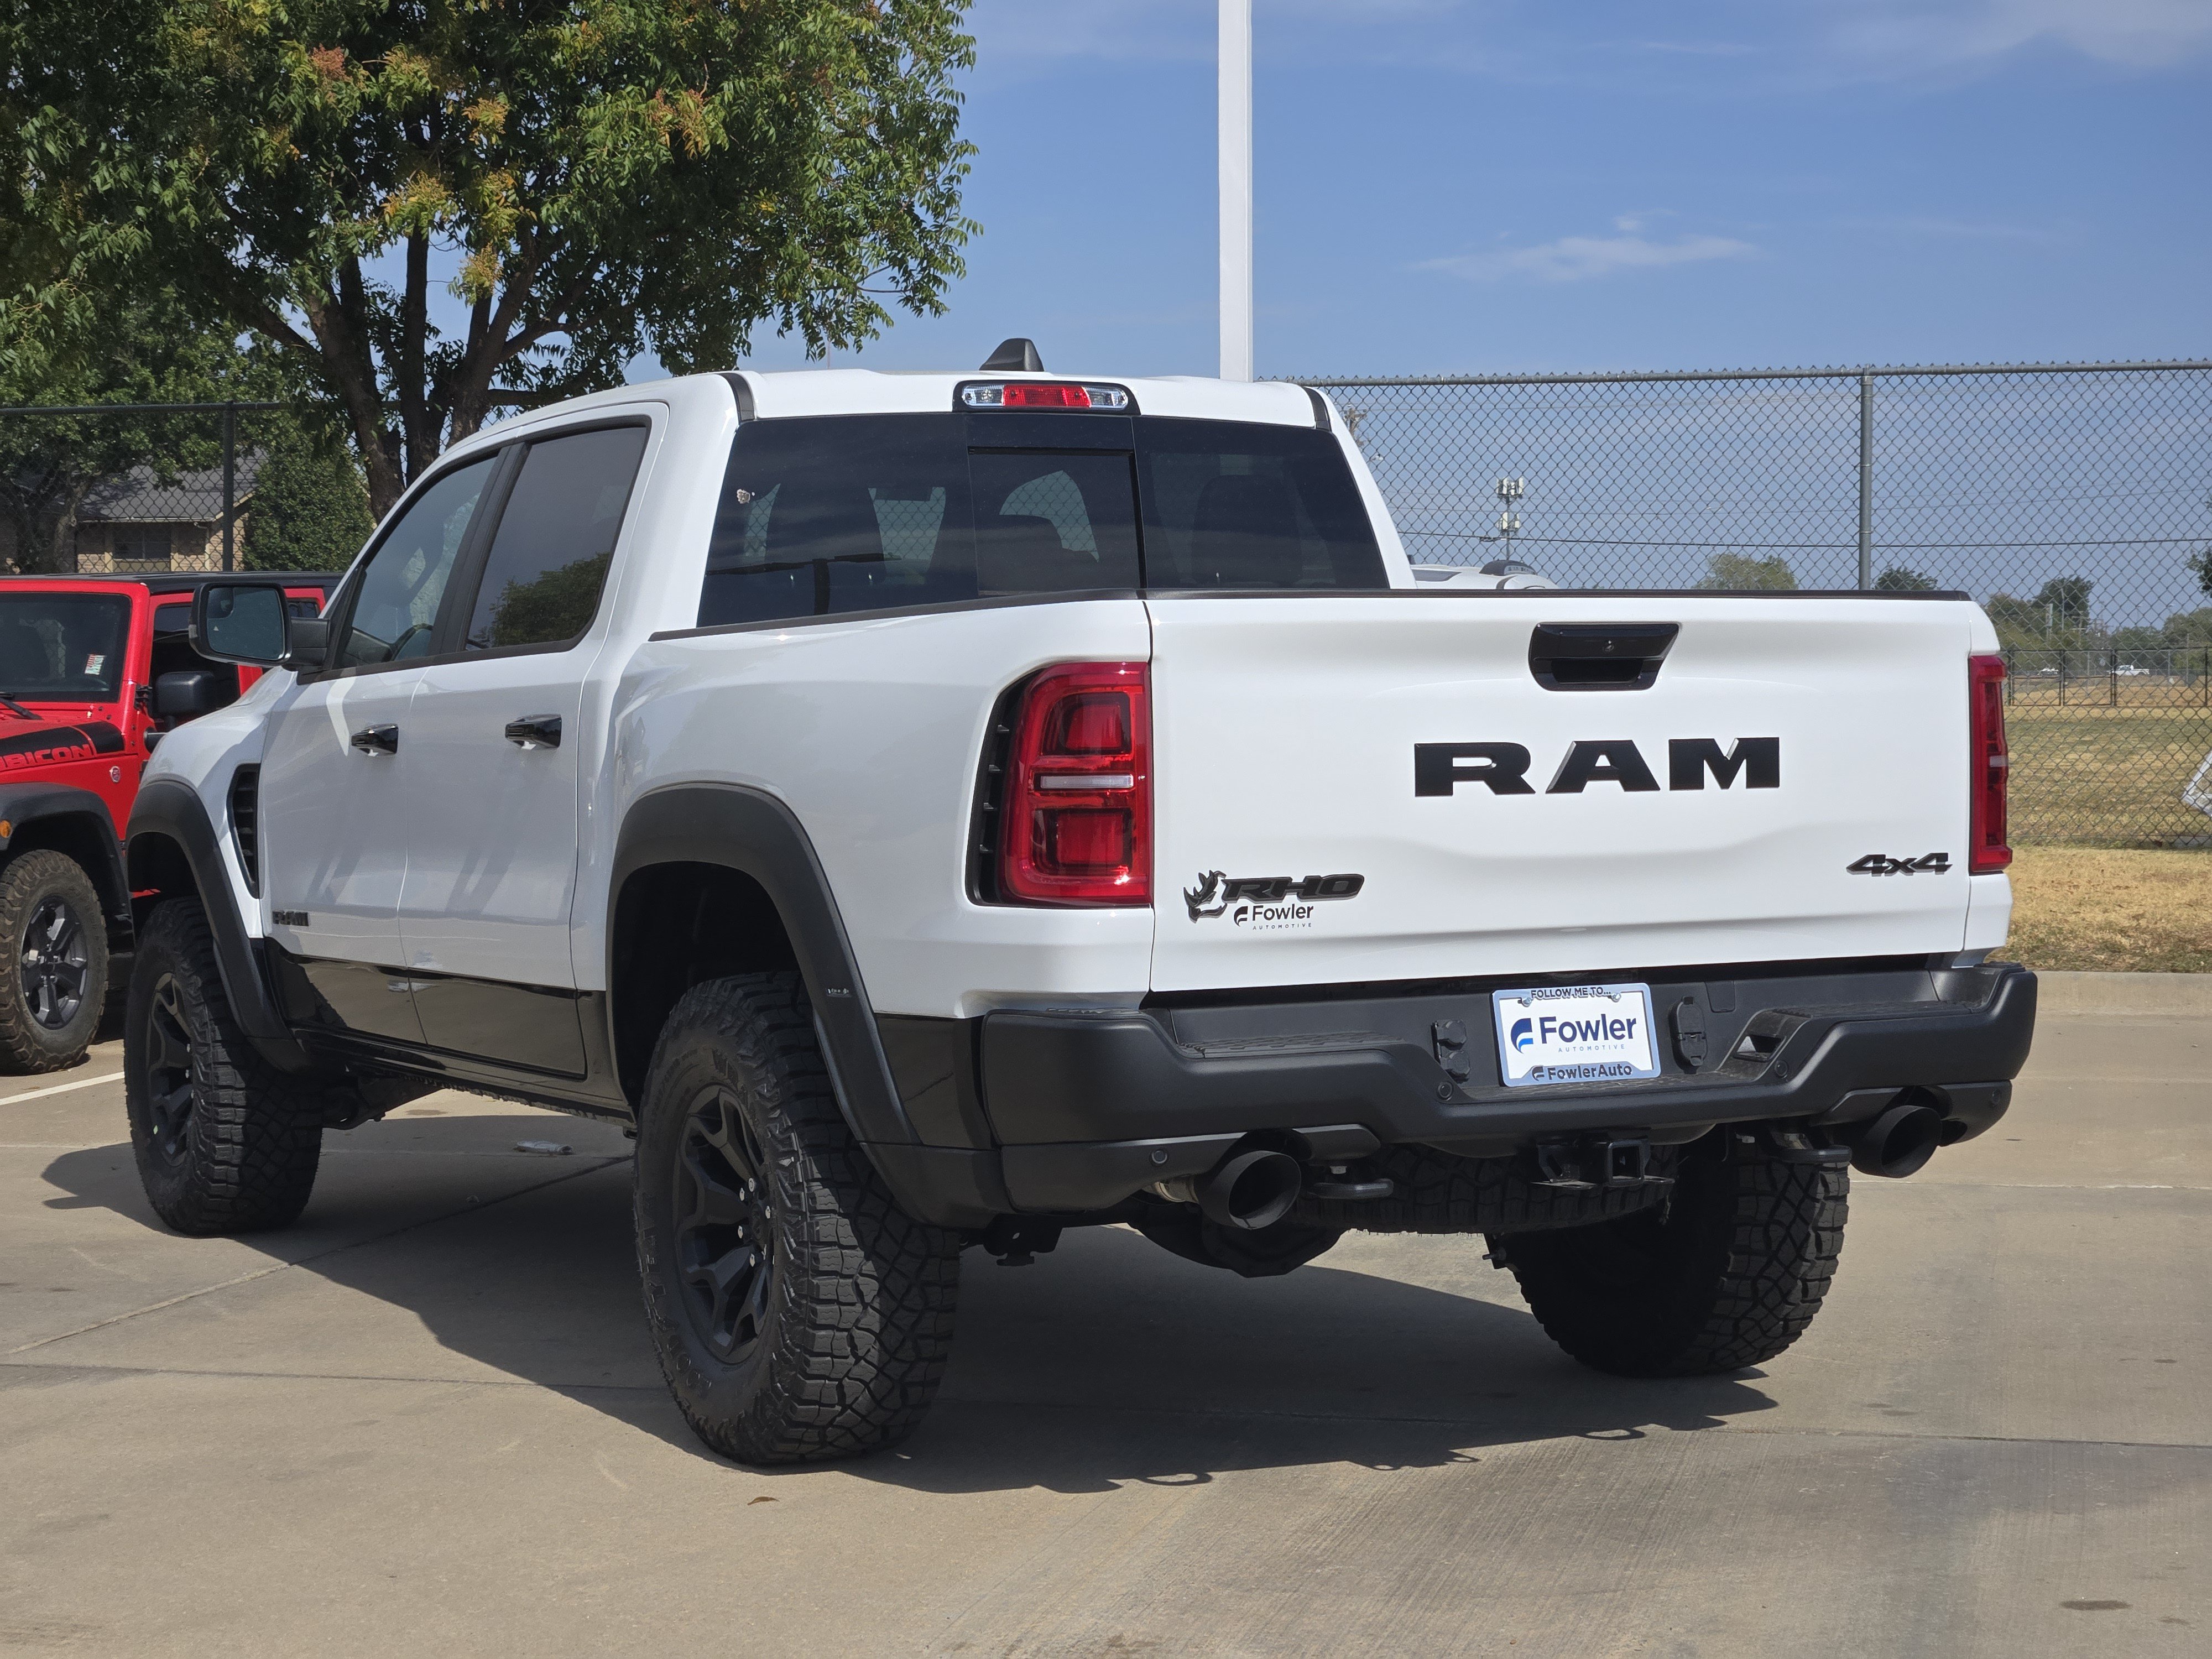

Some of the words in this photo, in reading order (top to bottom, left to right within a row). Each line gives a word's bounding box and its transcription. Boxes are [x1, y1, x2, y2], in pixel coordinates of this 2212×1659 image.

[0, 744, 94, 770] BICON
[1414, 737, 1780, 797] RAM
[1846, 852, 1953, 877] 4x4
[1221, 873, 1365, 904] RHO
[1252, 904, 1314, 921] Fowler
[1531, 988, 1572, 999] FOLLOW
[1575, 987, 1588, 997] ME
[1539, 1013, 1637, 1044] Fowler
[1558, 1044, 1625, 1053] AUTOMOTIVE
[1548, 1063, 1632, 1081] FowlerAuto
